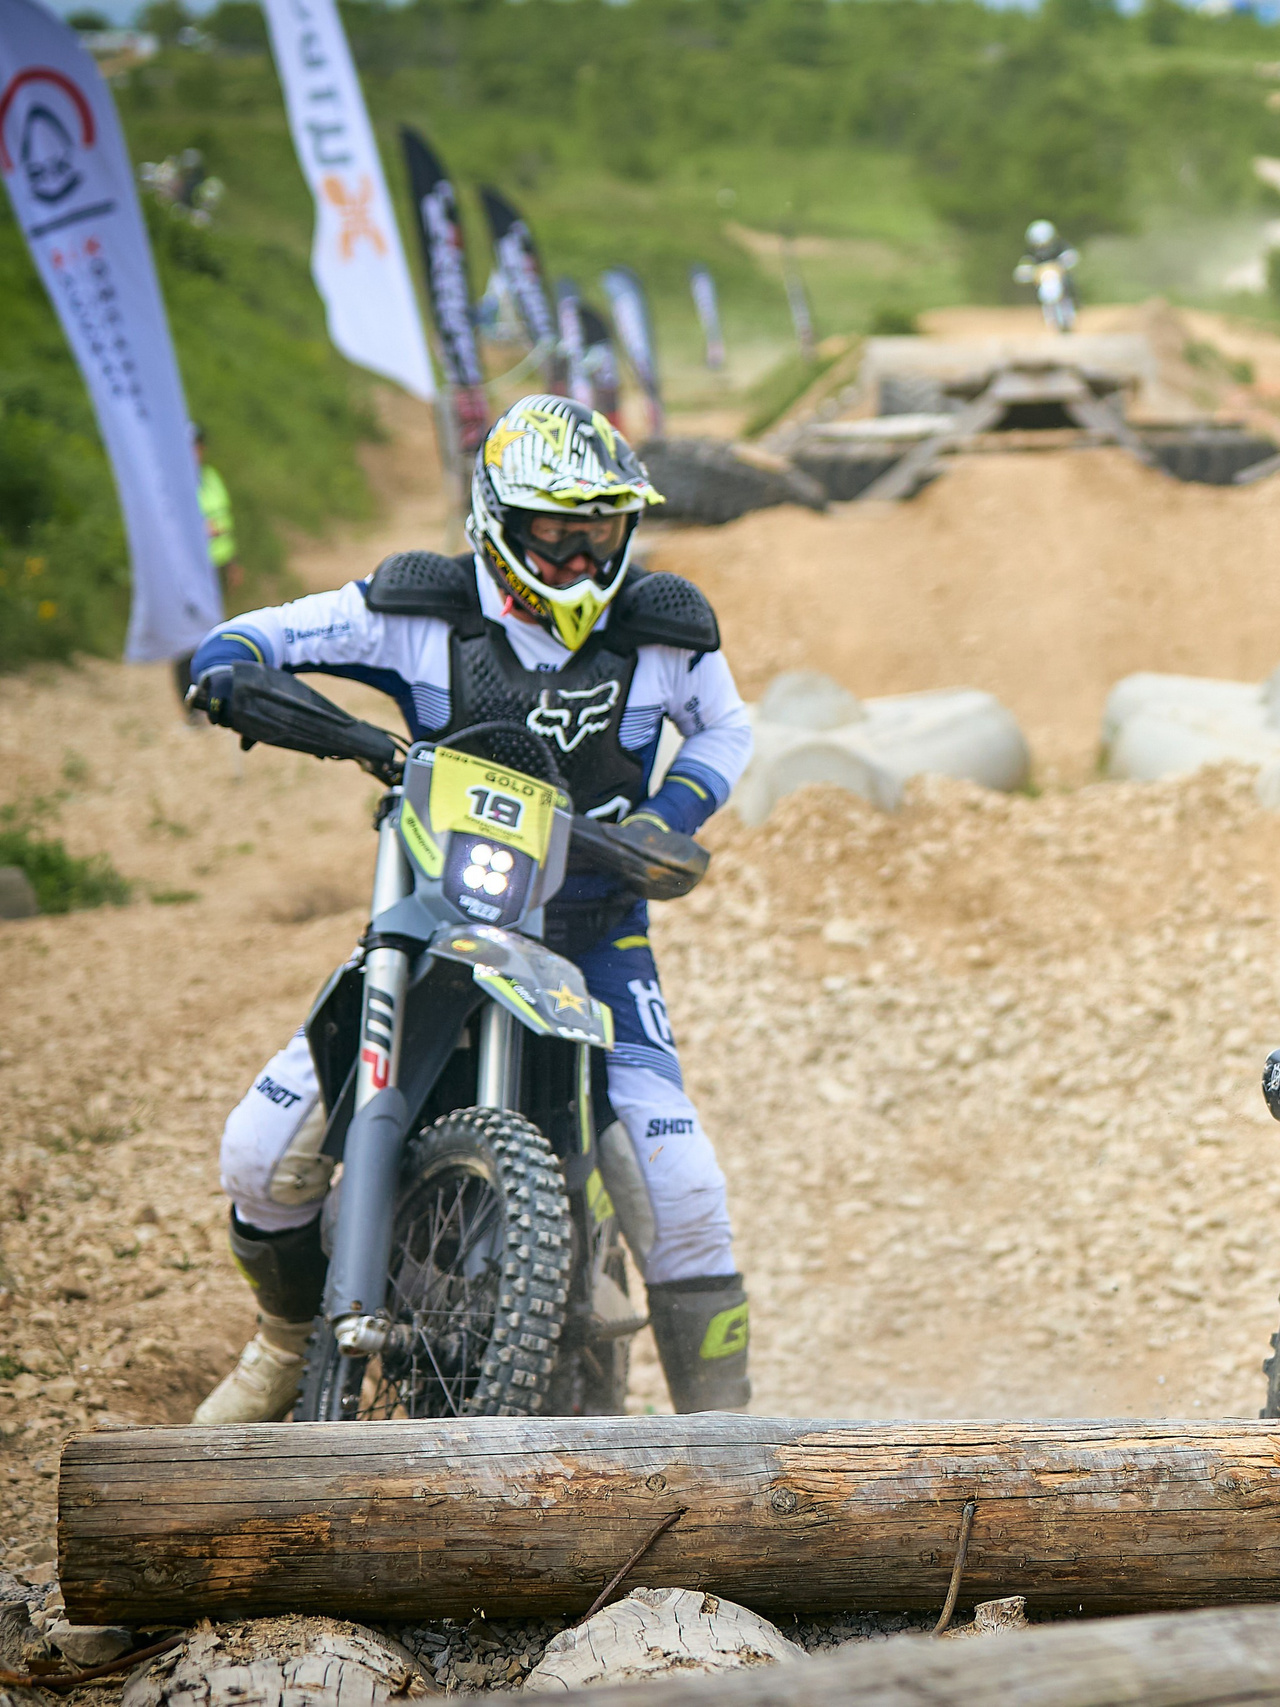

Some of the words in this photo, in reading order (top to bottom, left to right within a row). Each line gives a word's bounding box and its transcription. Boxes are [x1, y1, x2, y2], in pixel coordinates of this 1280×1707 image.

[484, 772, 535, 797] GOLD
[468, 787, 523, 829] 19
[645, 1117, 694, 1139] SHOT
